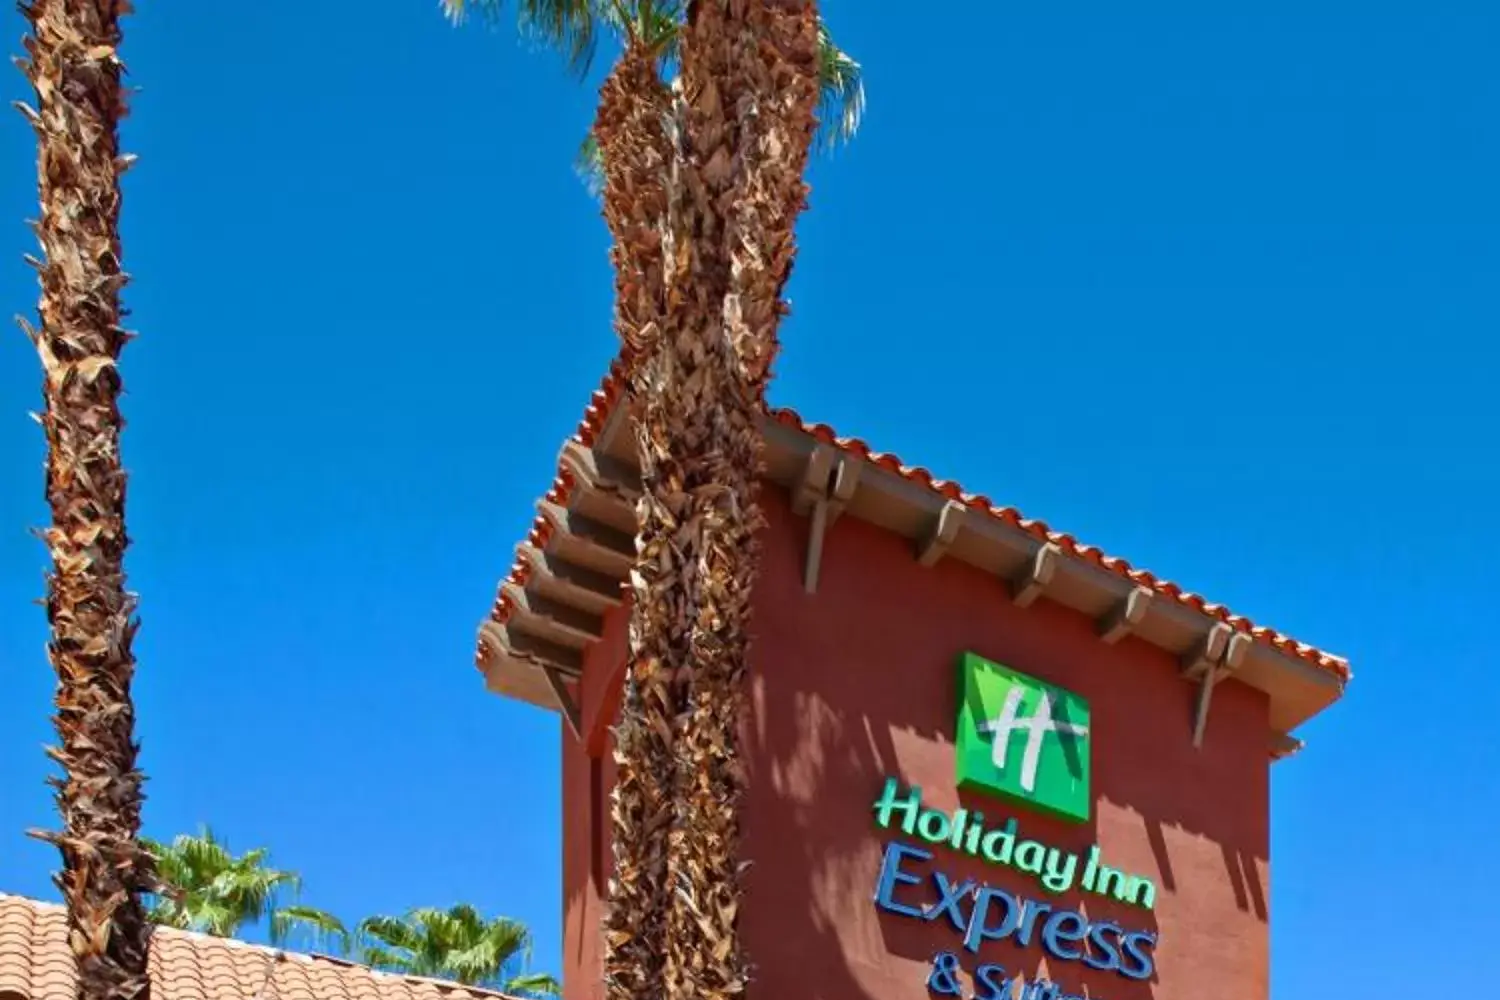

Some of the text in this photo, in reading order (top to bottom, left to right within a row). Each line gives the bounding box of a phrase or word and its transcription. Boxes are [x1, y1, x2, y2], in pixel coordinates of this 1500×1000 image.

[977, 683, 1089, 792] H
[873, 777, 1157, 909] Holiday Inn
[874, 841, 1158, 979] Express
[925, 951, 964, 996] &
